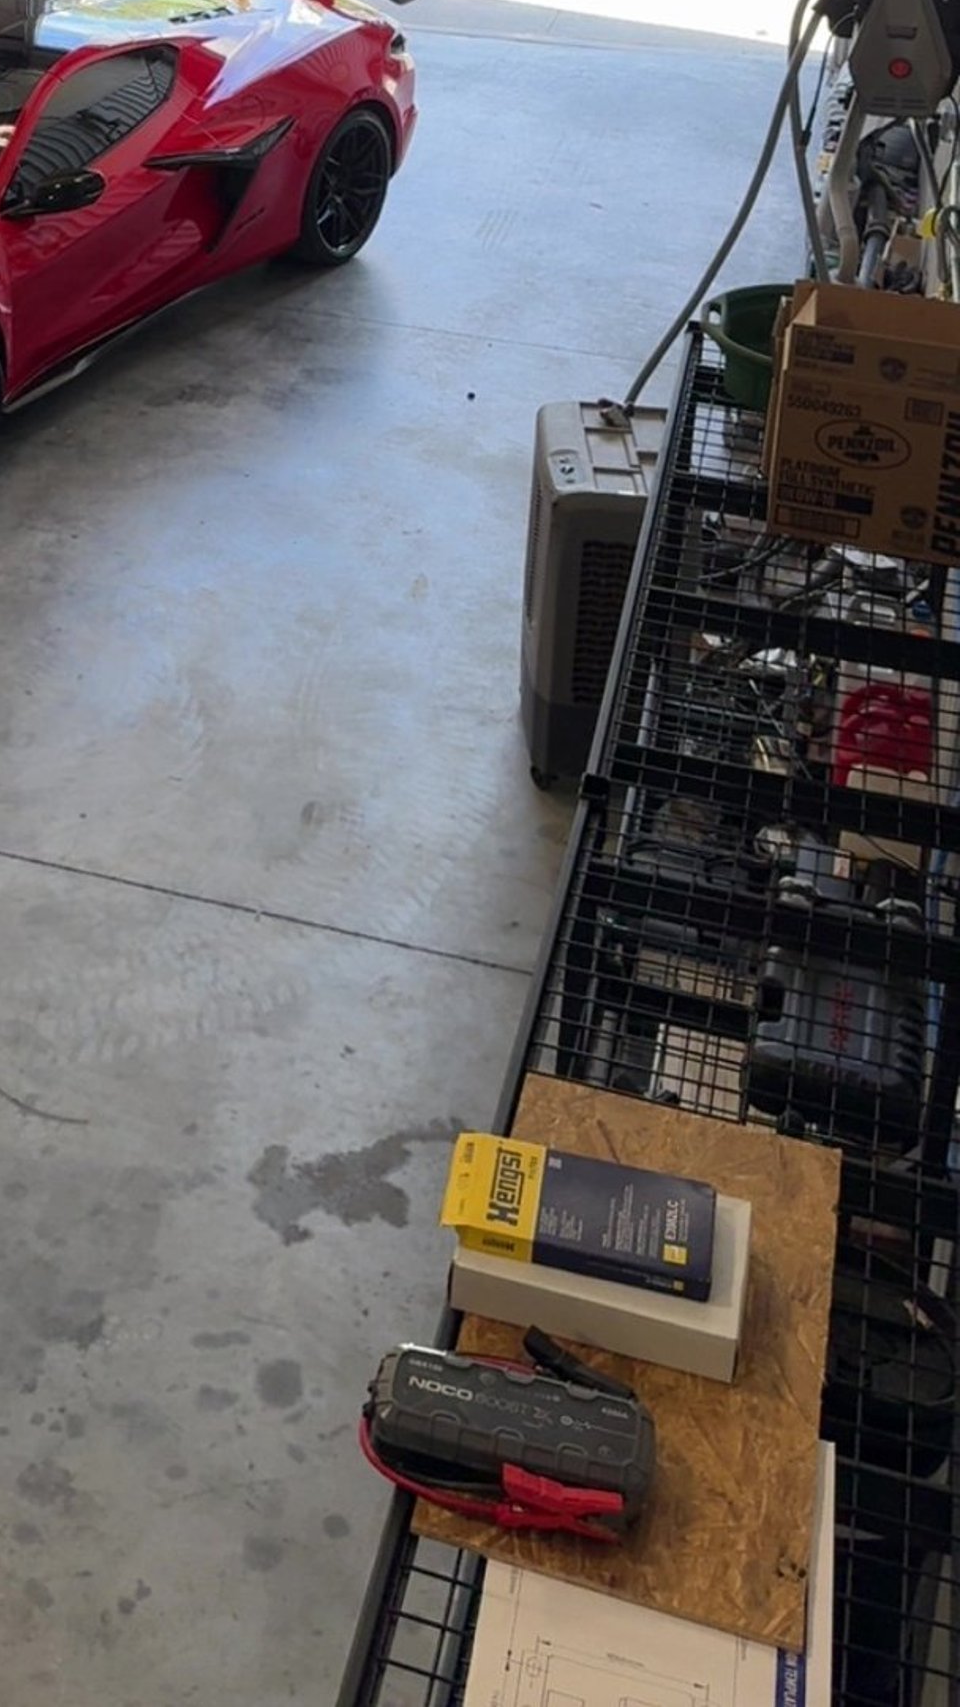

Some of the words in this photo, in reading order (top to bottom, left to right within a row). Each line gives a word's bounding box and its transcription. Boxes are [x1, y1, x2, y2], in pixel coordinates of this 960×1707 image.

[827, 434, 897, 453] PENNZOIL
[486, 1145, 526, 1228] Hengst
[409, 1375, 474, 1401] NOCO
